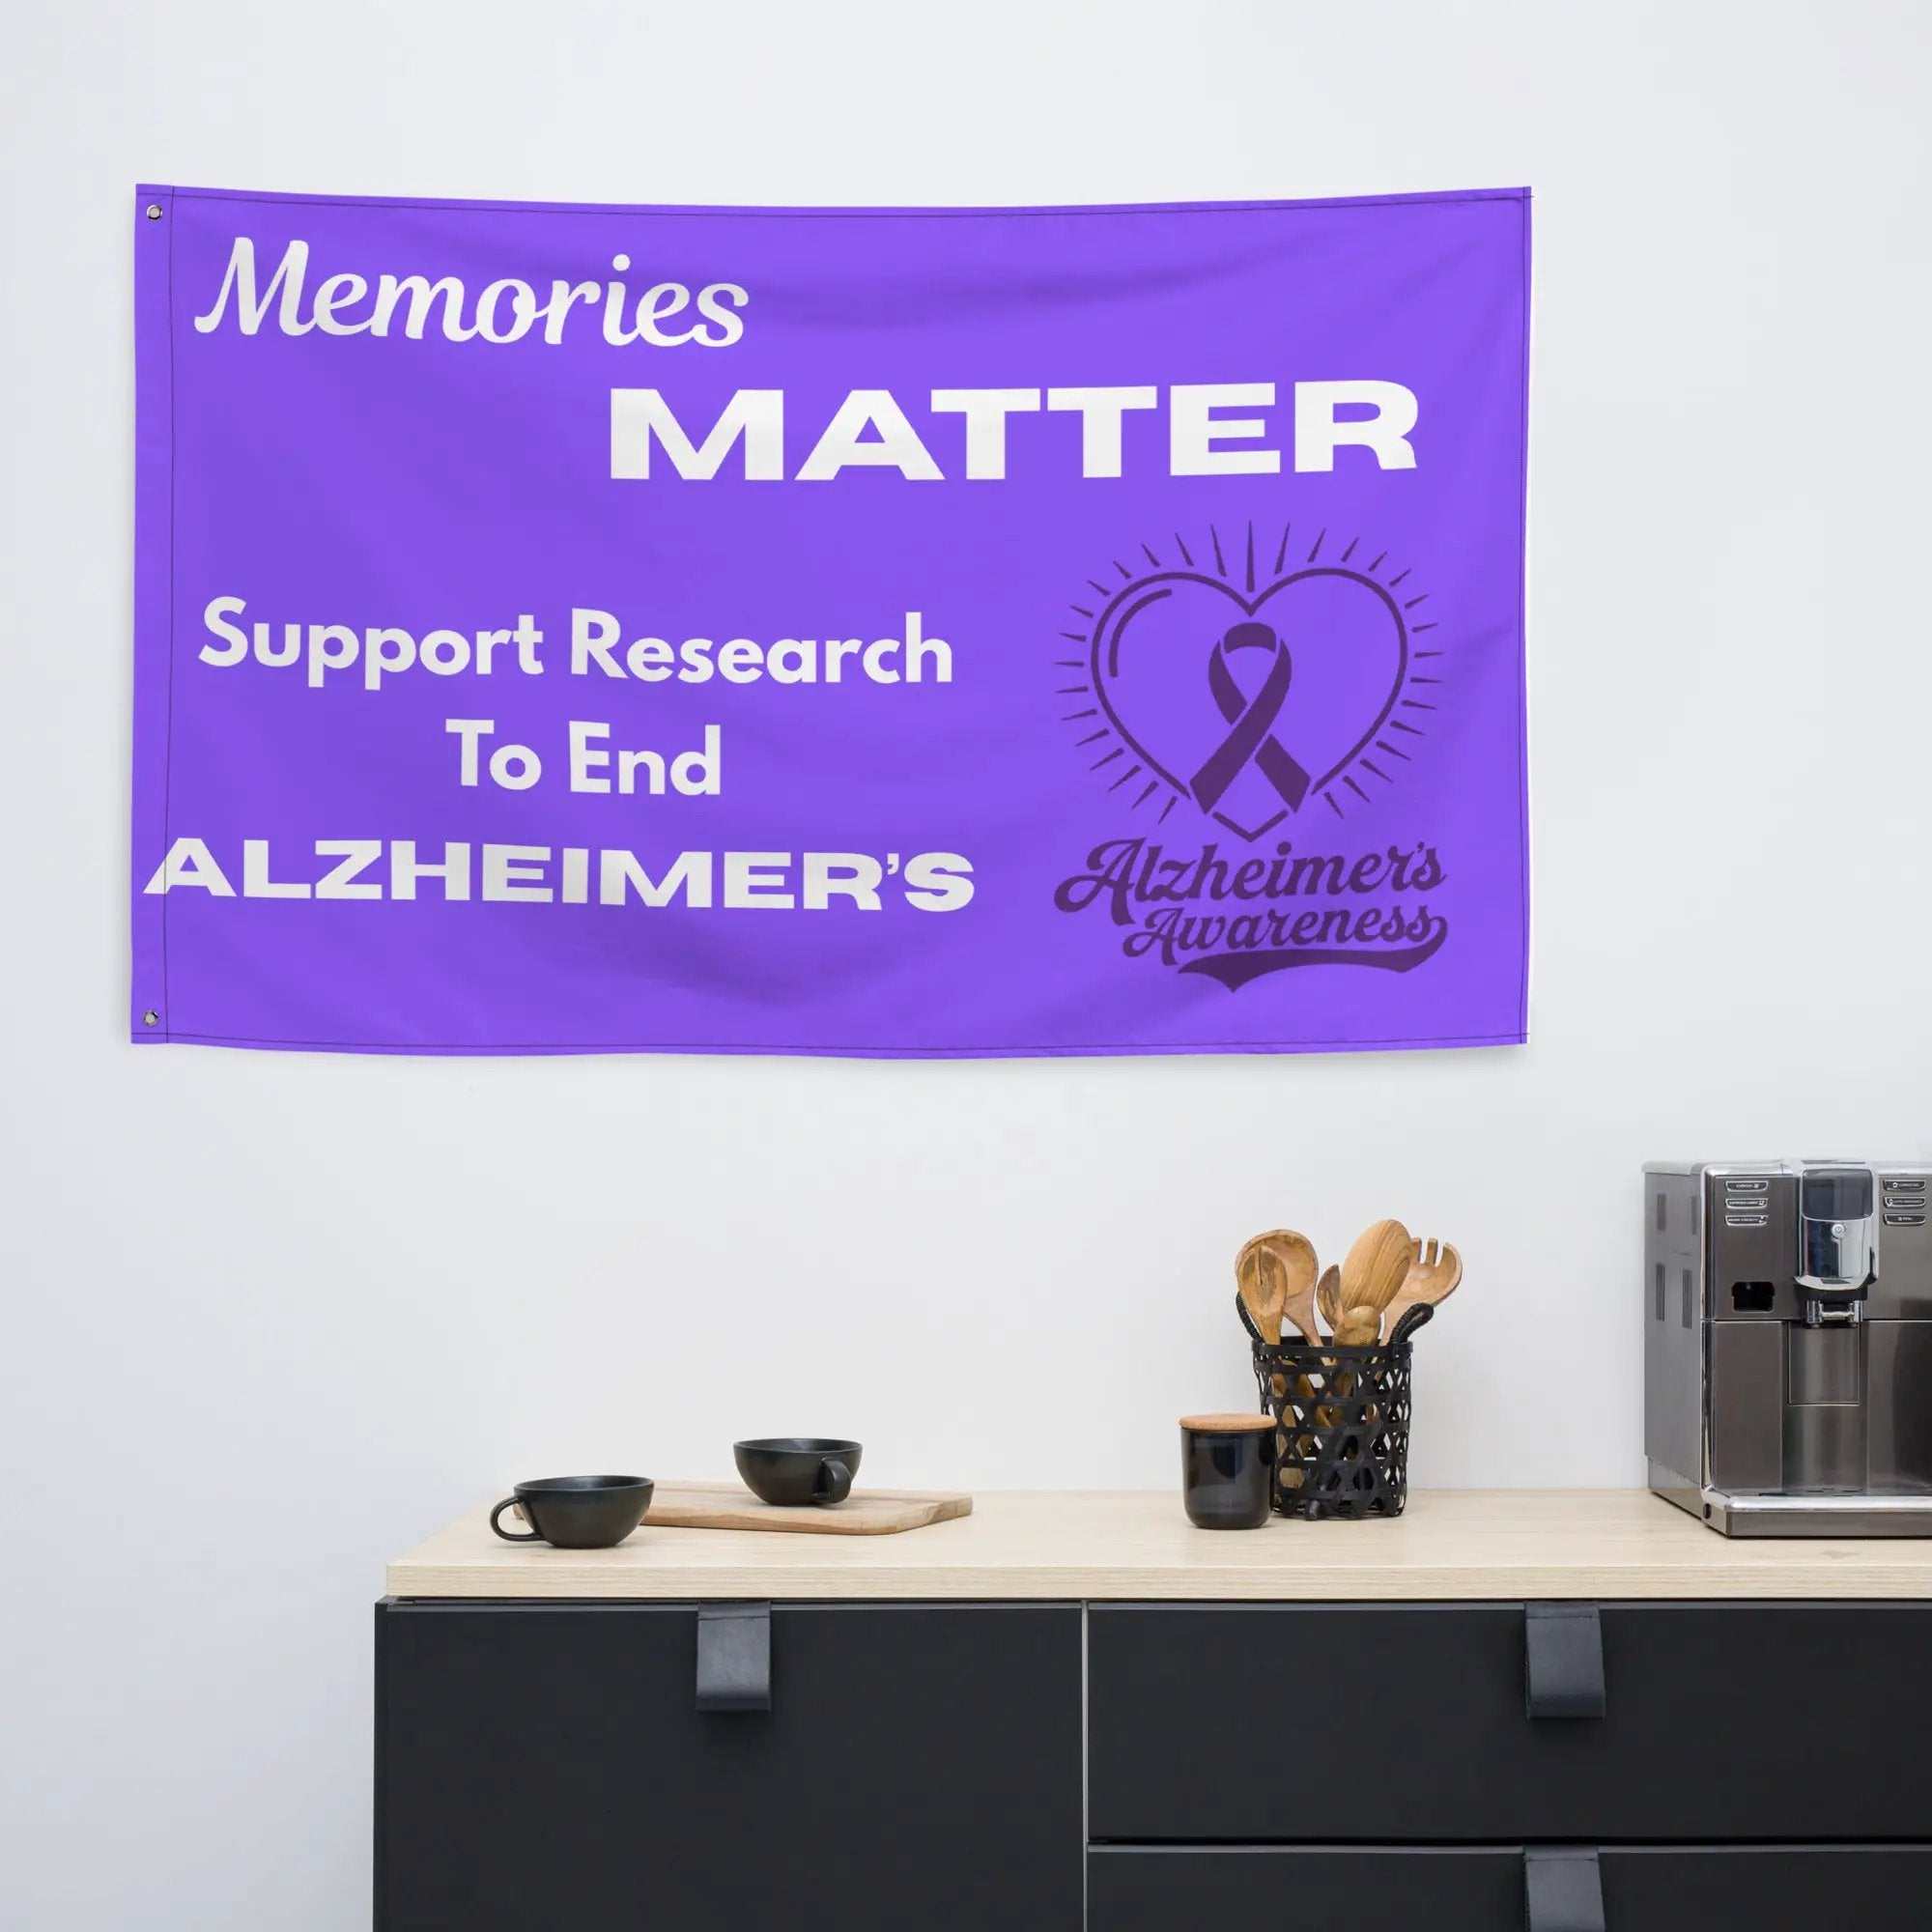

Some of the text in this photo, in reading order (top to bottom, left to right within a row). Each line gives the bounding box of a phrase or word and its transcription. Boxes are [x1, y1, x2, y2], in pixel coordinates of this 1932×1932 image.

[194, 237, 749, 348] Memories
[611, 380, 1418, 481] MATTER
[198, 596, 952, 691] Support Research
[445, 718, 721, 796] To End
[143, 838, 975, 912] ALZHEIMER'S
[1054, 837, 1447, 926] Alzheimer's
[1122, 905, 1447, 967] Awareness
